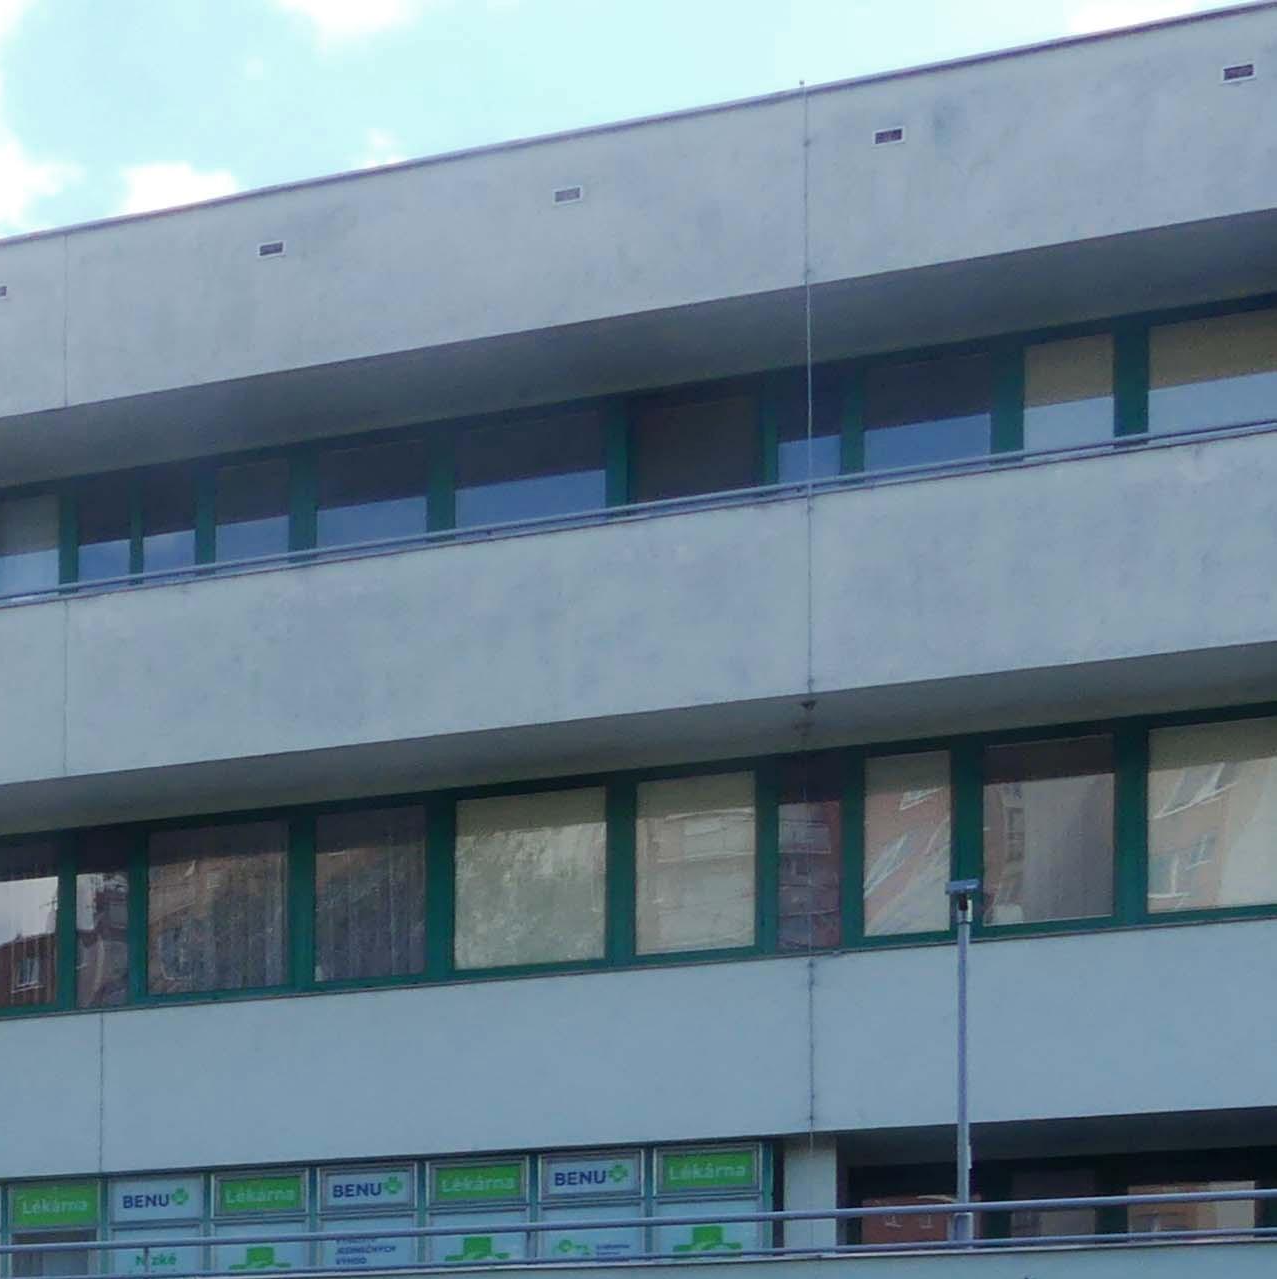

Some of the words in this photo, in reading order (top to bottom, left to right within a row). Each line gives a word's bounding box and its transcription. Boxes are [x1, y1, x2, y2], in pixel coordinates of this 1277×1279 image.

[554, 1170, 606, 1186] BENU
[333, 1182, 382, 1198] BENU
[122, 1193, 169, 1209] BENU
[136, 1252, 177, 1266] Nzké
